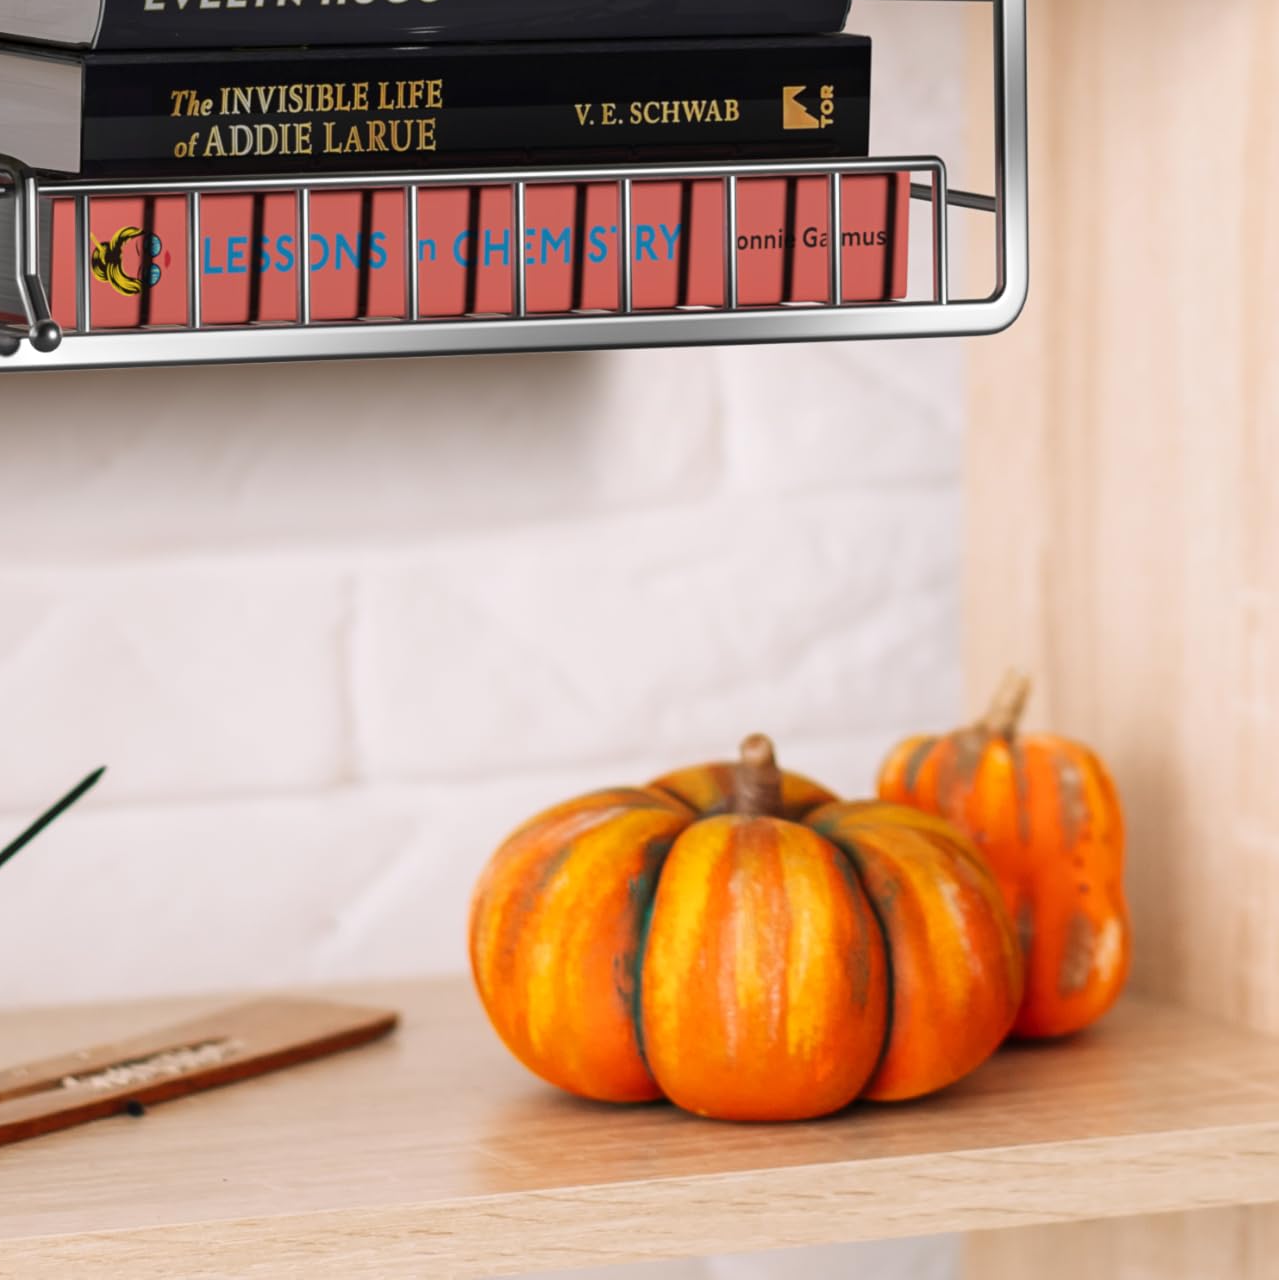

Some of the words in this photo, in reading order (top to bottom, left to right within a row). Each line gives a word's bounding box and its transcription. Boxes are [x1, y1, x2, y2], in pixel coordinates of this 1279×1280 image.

[170, 90, 213, 117] The
[219, 82, 369, 115] INVISIBLE
[377, 79, 443, 110] LIFE
[575, 104, 595, 125] V.
[601, 103, 624, 125] E.
[630, 99, 740, 124] SCHWAB
[820, 85, 834, 129] TOR
[174, 131, 199, 158] of
[202, 122, 313, 157] ADDIE
[323, 118, 437, 153] LARUE
[453, 224, 682, 269] CHEMSRY
[736, 228, 796, 250] onni
[802, 226, 888, 248] Gamus
